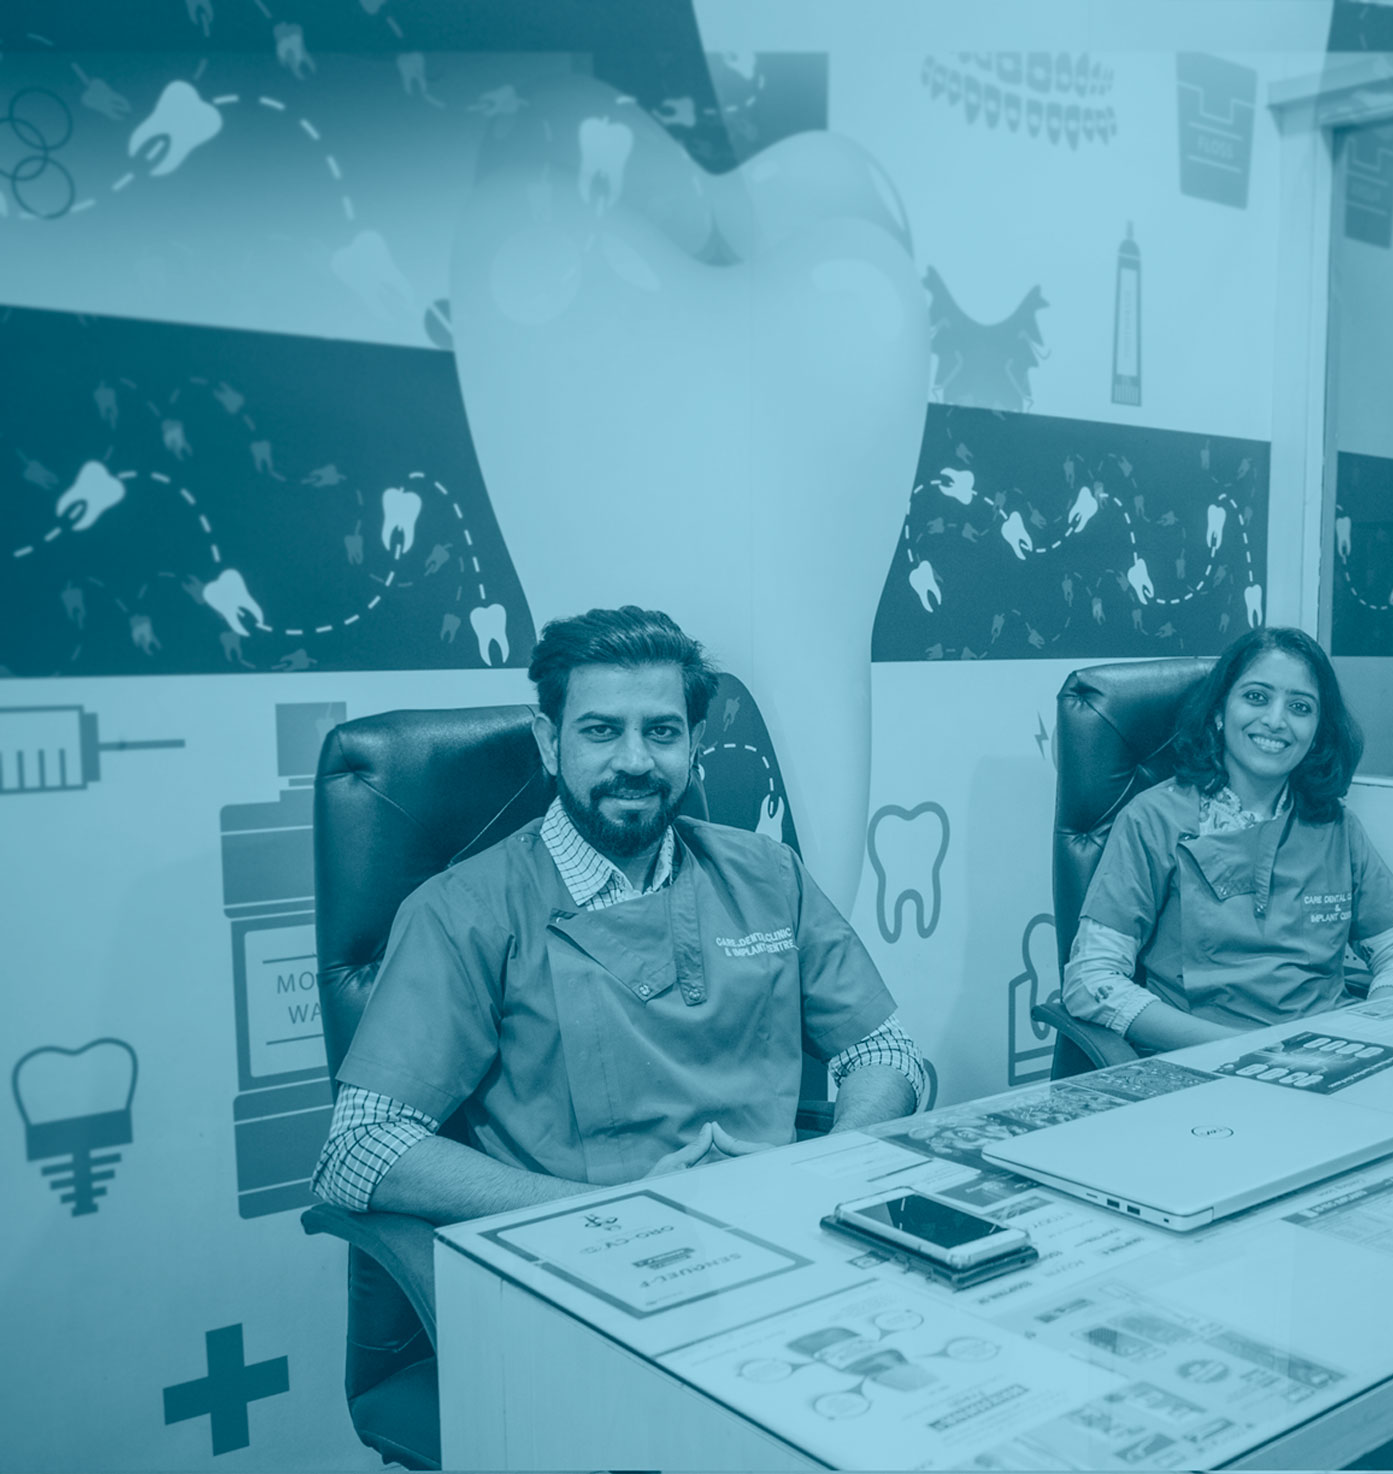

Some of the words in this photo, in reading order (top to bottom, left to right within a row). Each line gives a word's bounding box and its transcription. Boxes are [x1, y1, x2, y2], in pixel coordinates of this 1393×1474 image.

[1324, 894, 1346, 904] DENTAL
[1334, 903, 1341, 911] &
[1310, 912, 1338, 923] IMPLANT
[764, 927, 792, 942] CLINIC
